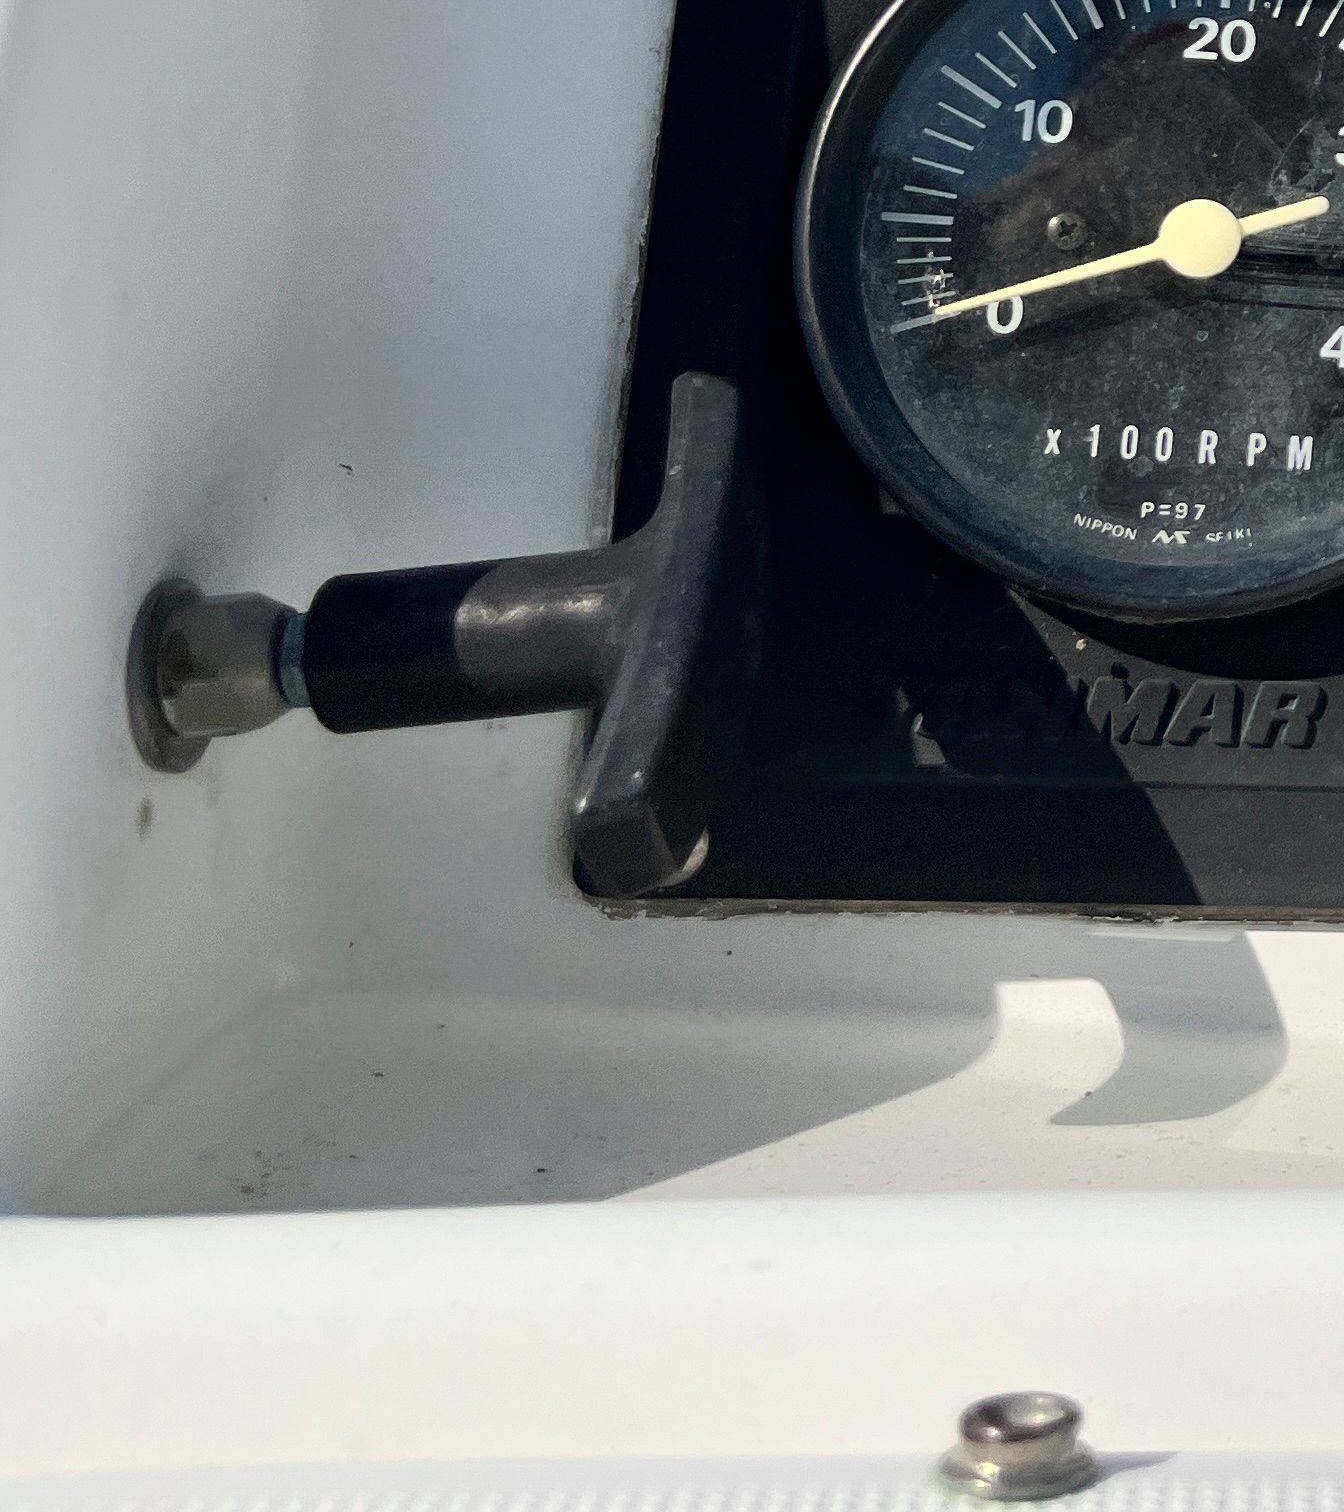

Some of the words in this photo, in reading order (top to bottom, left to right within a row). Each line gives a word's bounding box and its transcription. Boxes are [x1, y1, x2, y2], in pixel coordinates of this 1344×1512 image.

[1182, 16, 1257, 63] 20
[1012, 98, 1074, 144] 10
[985, 294, 1025, 335] 0
[1073, 513, 1138, 541] NIPPON
[1140, 501, 1207, 521] P=97
